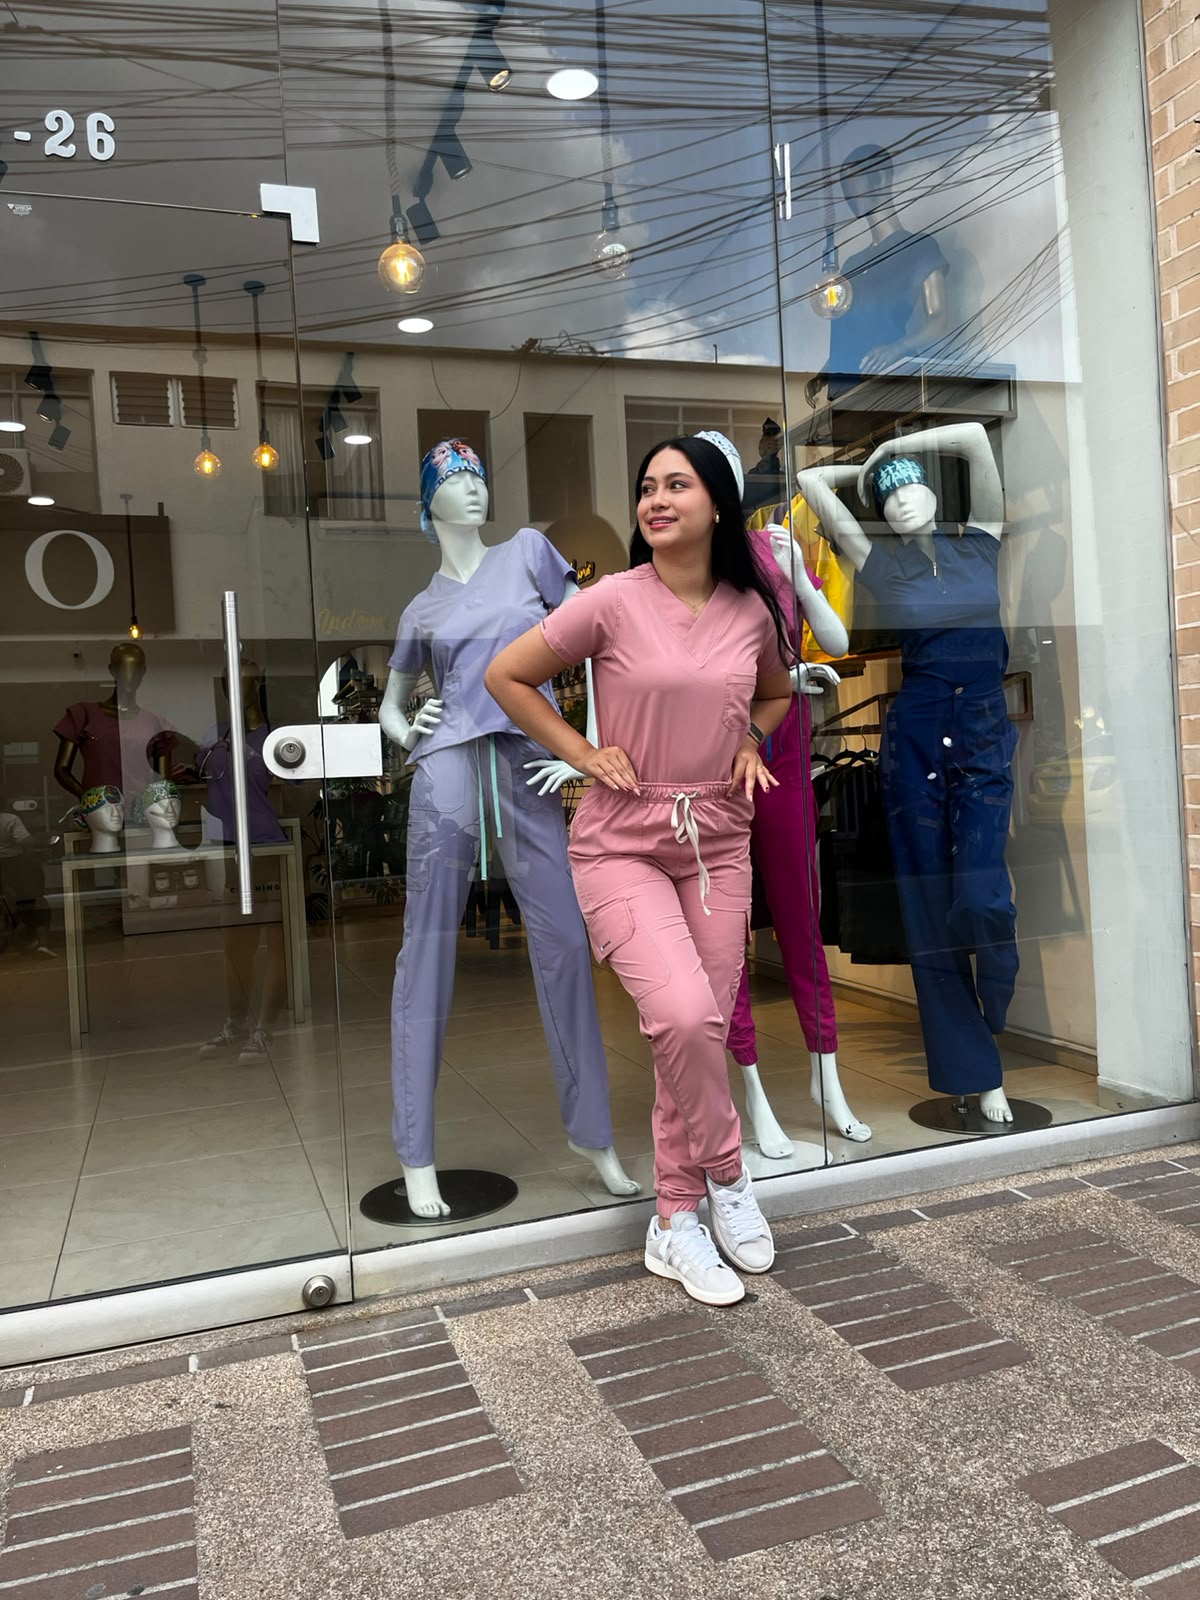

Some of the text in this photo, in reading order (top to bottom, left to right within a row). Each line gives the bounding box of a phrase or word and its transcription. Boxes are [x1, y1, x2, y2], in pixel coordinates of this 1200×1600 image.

[13, 109, 116, 161] -26
[24, 529, 115, 610] O
[230, 884, 281, 894] CHING
